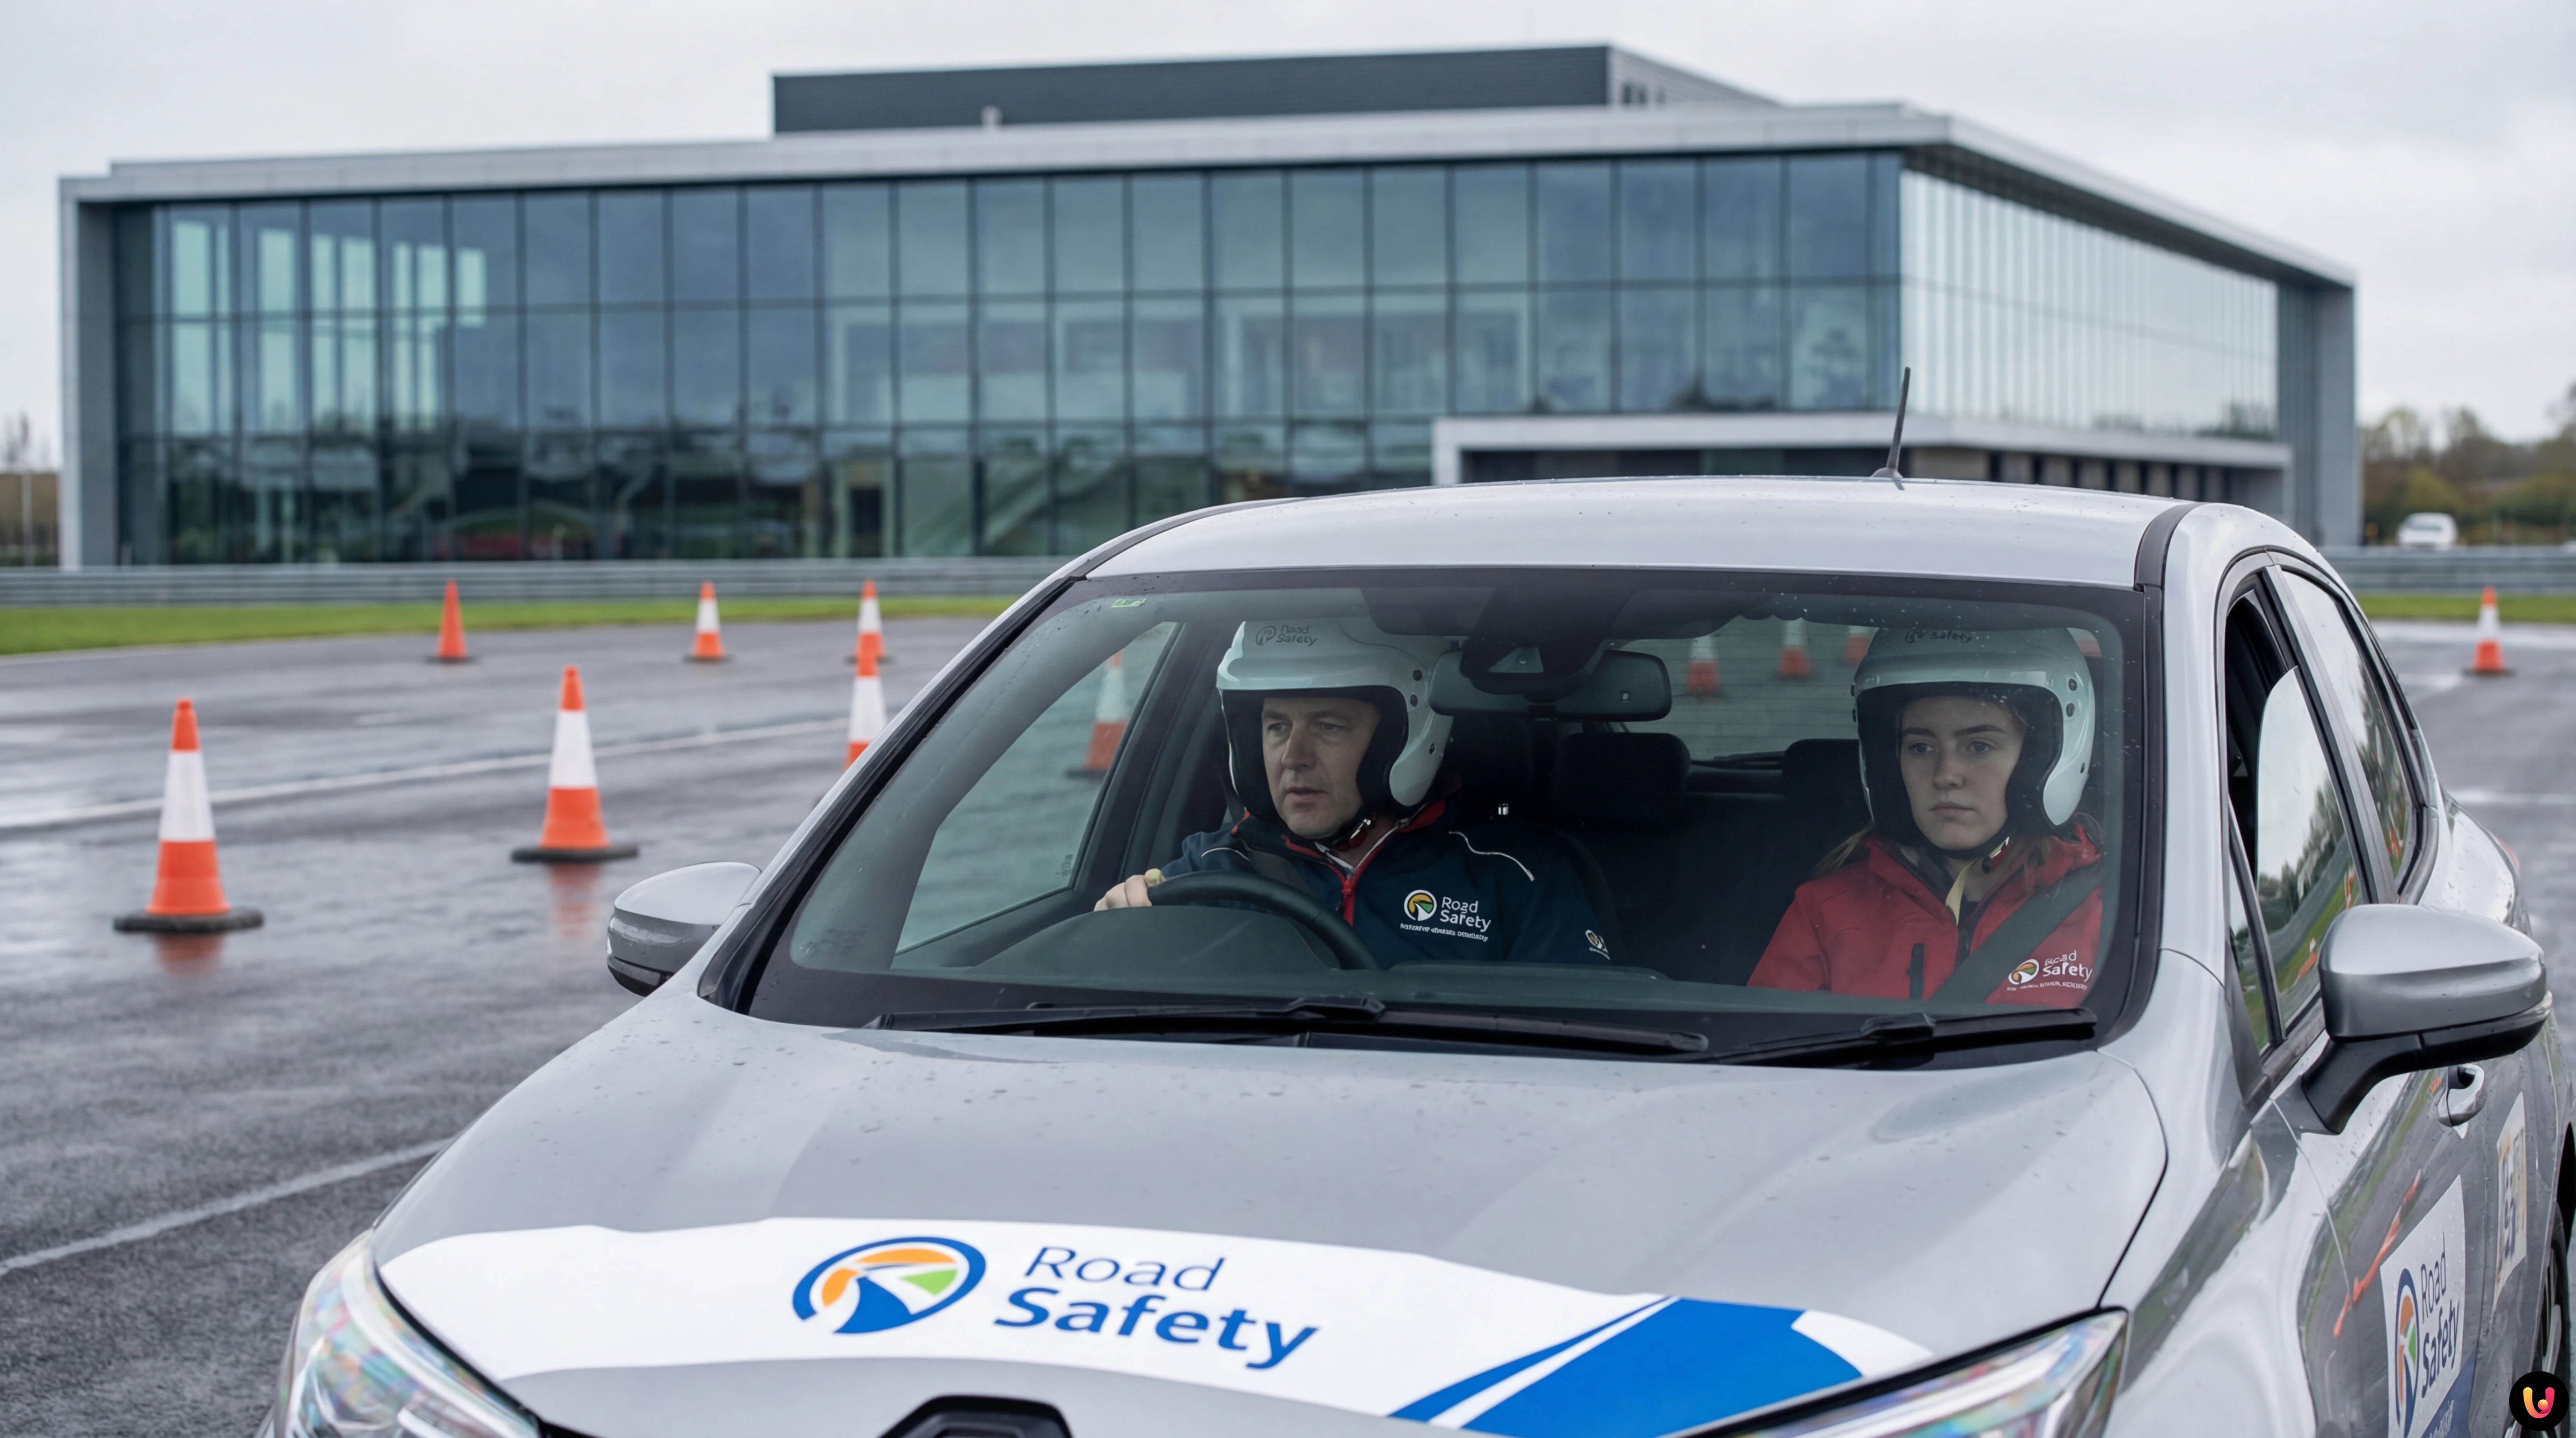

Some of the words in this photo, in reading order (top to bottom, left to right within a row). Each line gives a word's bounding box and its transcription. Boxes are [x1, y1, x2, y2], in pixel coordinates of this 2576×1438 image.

[1442, 896, 1478, 913] Road
[1024, 1247, 1226, 1291] Road
[2420, 1231, 2447, 1324] Road
[993, 1287, 1320, 1370] Safety
[2421, 1299, 2460, 1399] Safety
